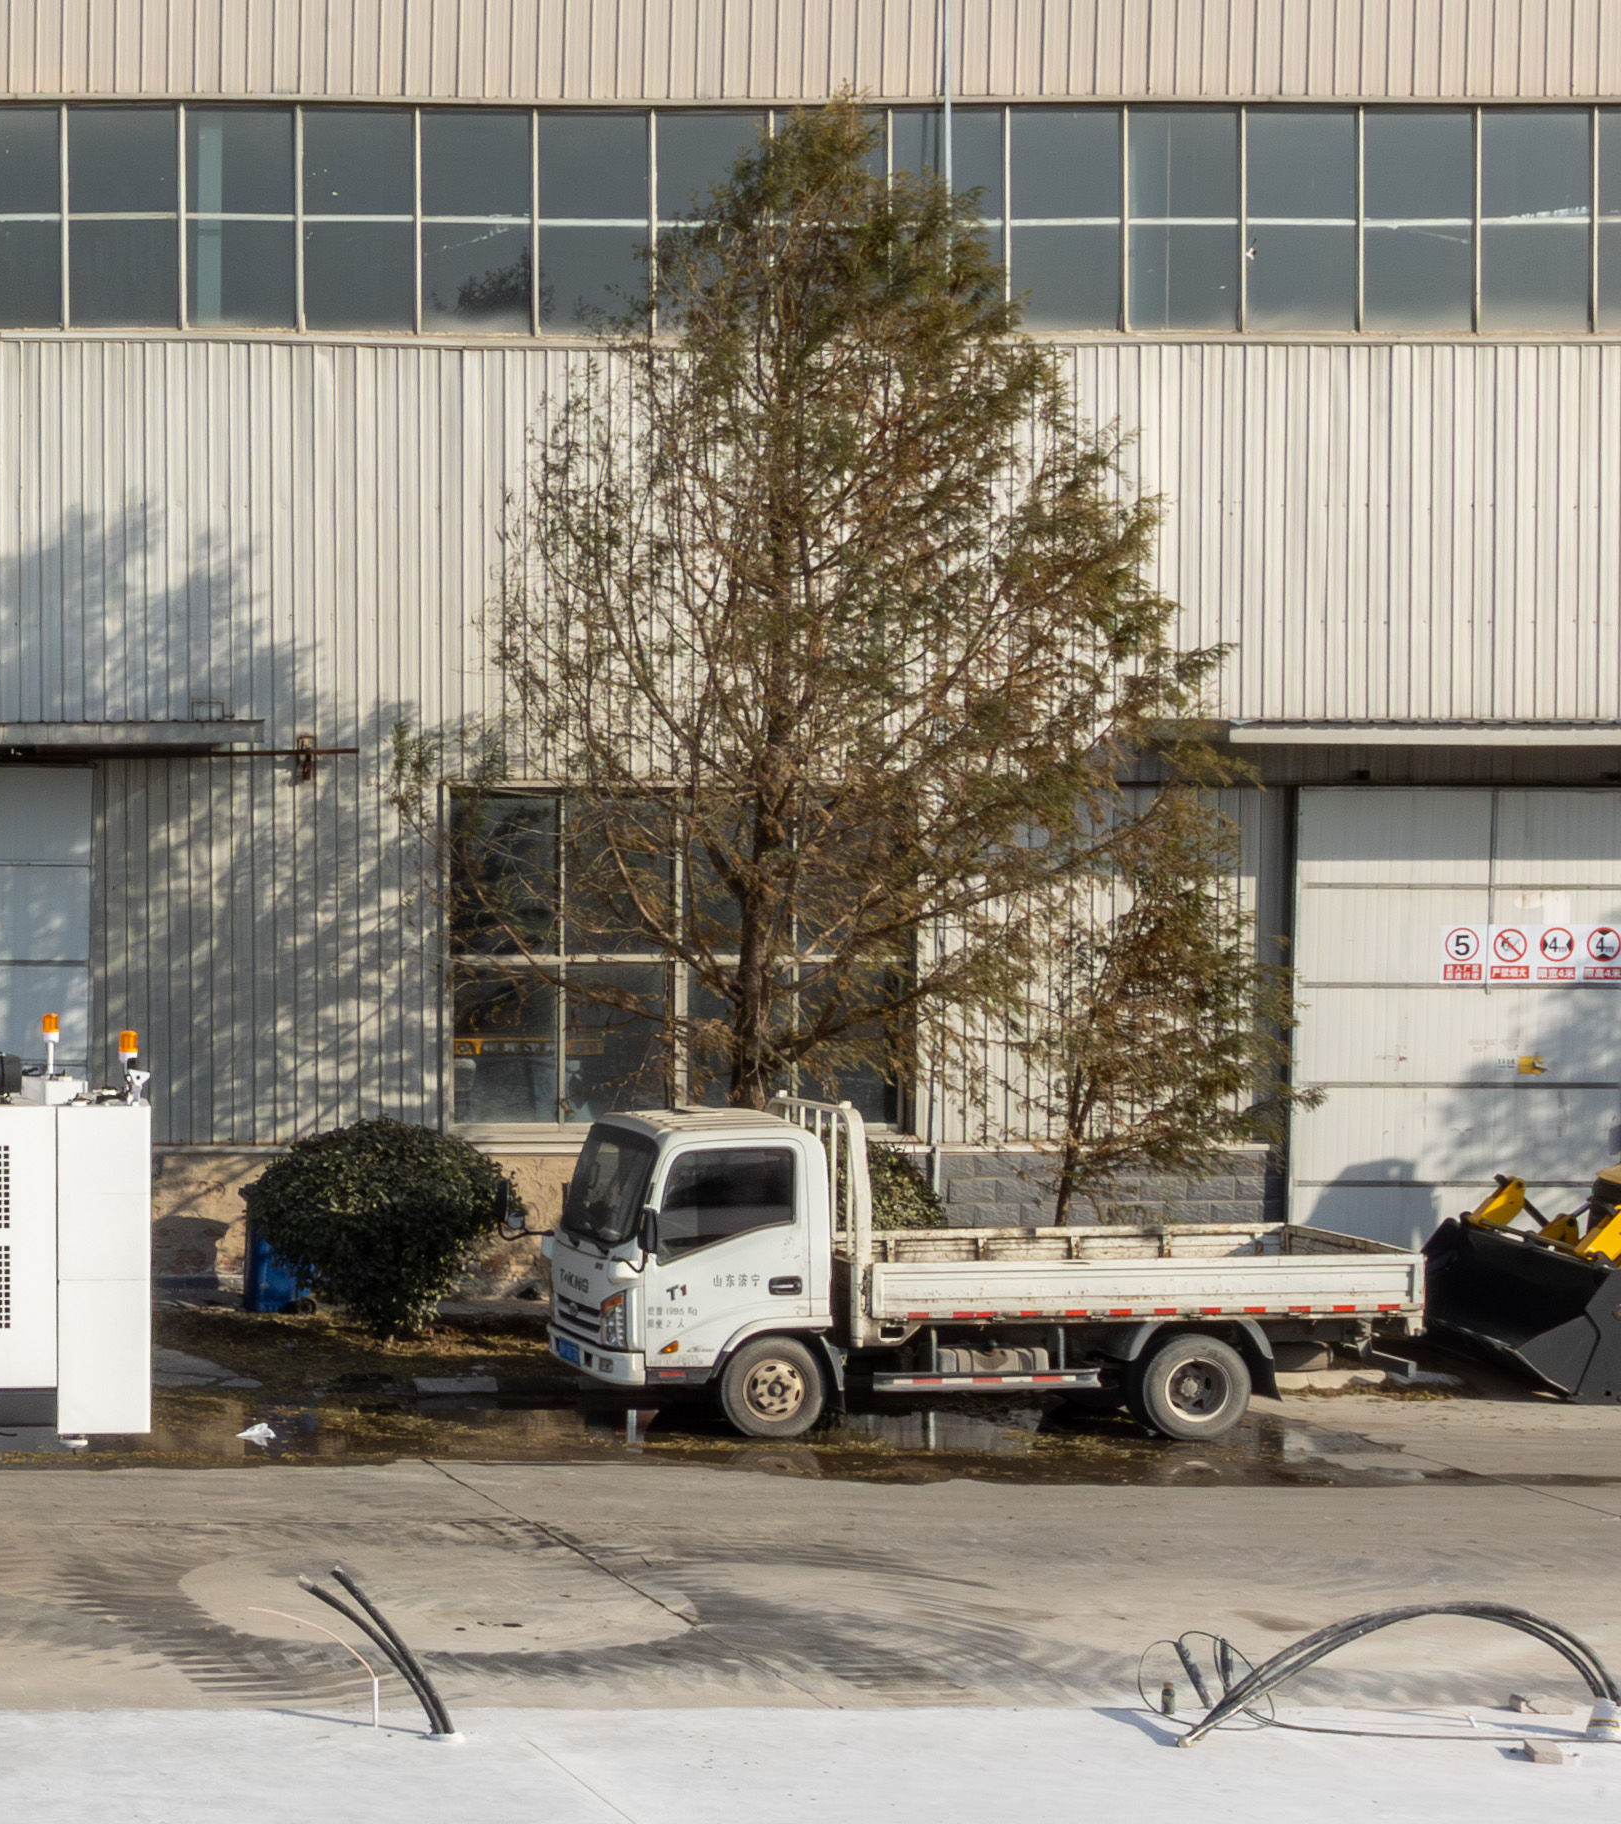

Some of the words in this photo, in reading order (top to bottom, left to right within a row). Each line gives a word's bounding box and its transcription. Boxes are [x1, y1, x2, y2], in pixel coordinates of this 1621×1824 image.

[1455, 935, 1470, 956] 5
[1492, 967, 1528, 978] 严禁烟火
[1538, 968, 1574, 979] 限宽4米
[713, 1274, 760, 1288] 山东济宁
[666, 1284, 687, 1301] T1
